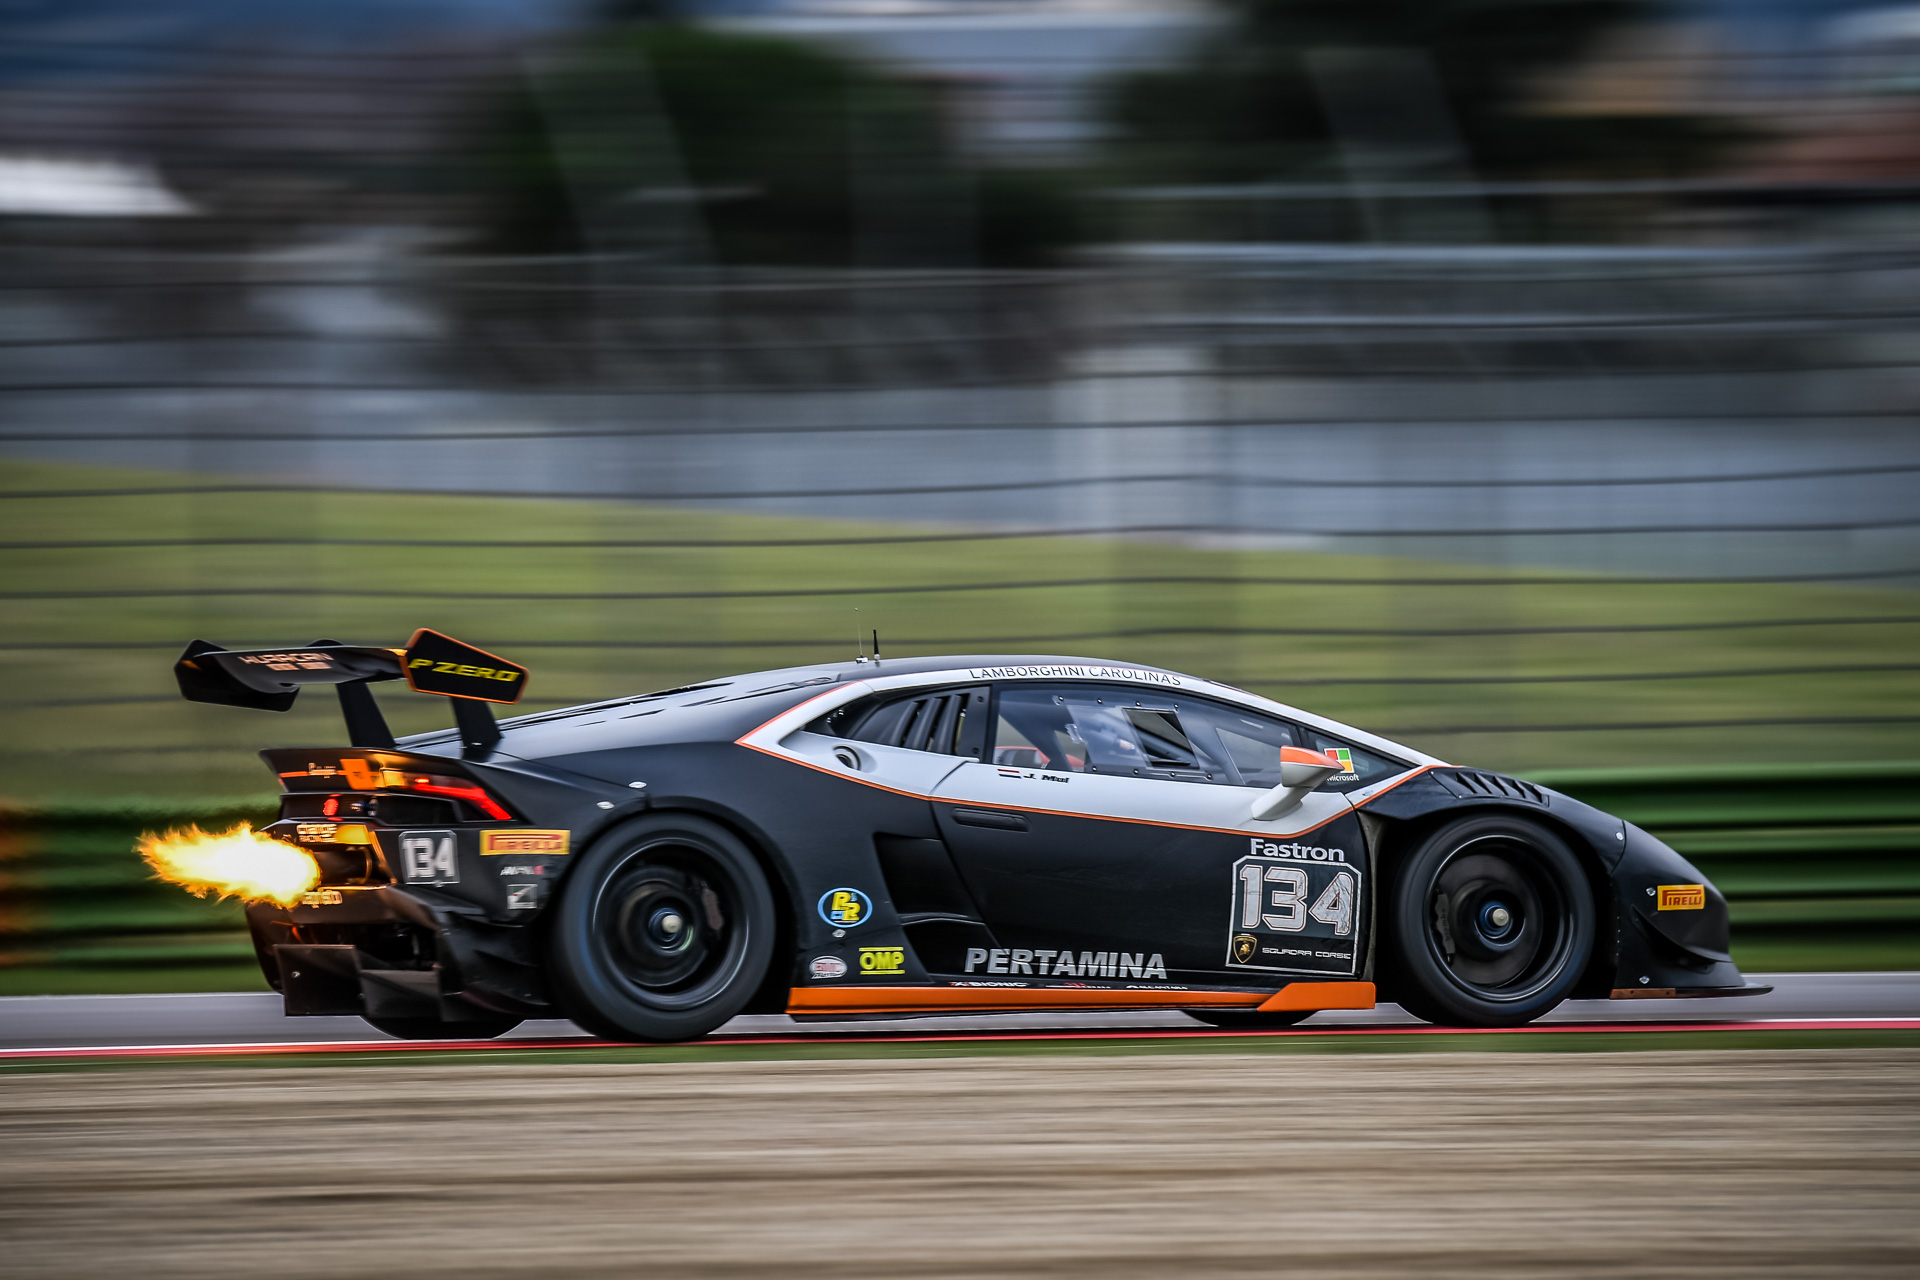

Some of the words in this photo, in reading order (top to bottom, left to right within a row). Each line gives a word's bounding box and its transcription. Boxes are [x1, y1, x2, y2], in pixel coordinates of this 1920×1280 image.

[408, 658, 434, 669] P
[431, 662, 521, 682] ZERO
[969, 665, 1085, 679] LAMBORGHINI
[1089, 666, 1181, 686] CAROLINAS
[488, 833, 563, 851] PIRELLI
[1250, 838, 1344, 862] Fastron
[403, 837, 455, 878] 134
[1239, 864, 1354, 936] 134
[1662, 888, 1702, 906] PIRELLI
[859, 951, 905, 970] OMP
[964, 947, 1168, 979] PERTAMINA
[1262, 947, 1312, 956] SQUADRA
[1315, 951, 1352, 960] CORSE
